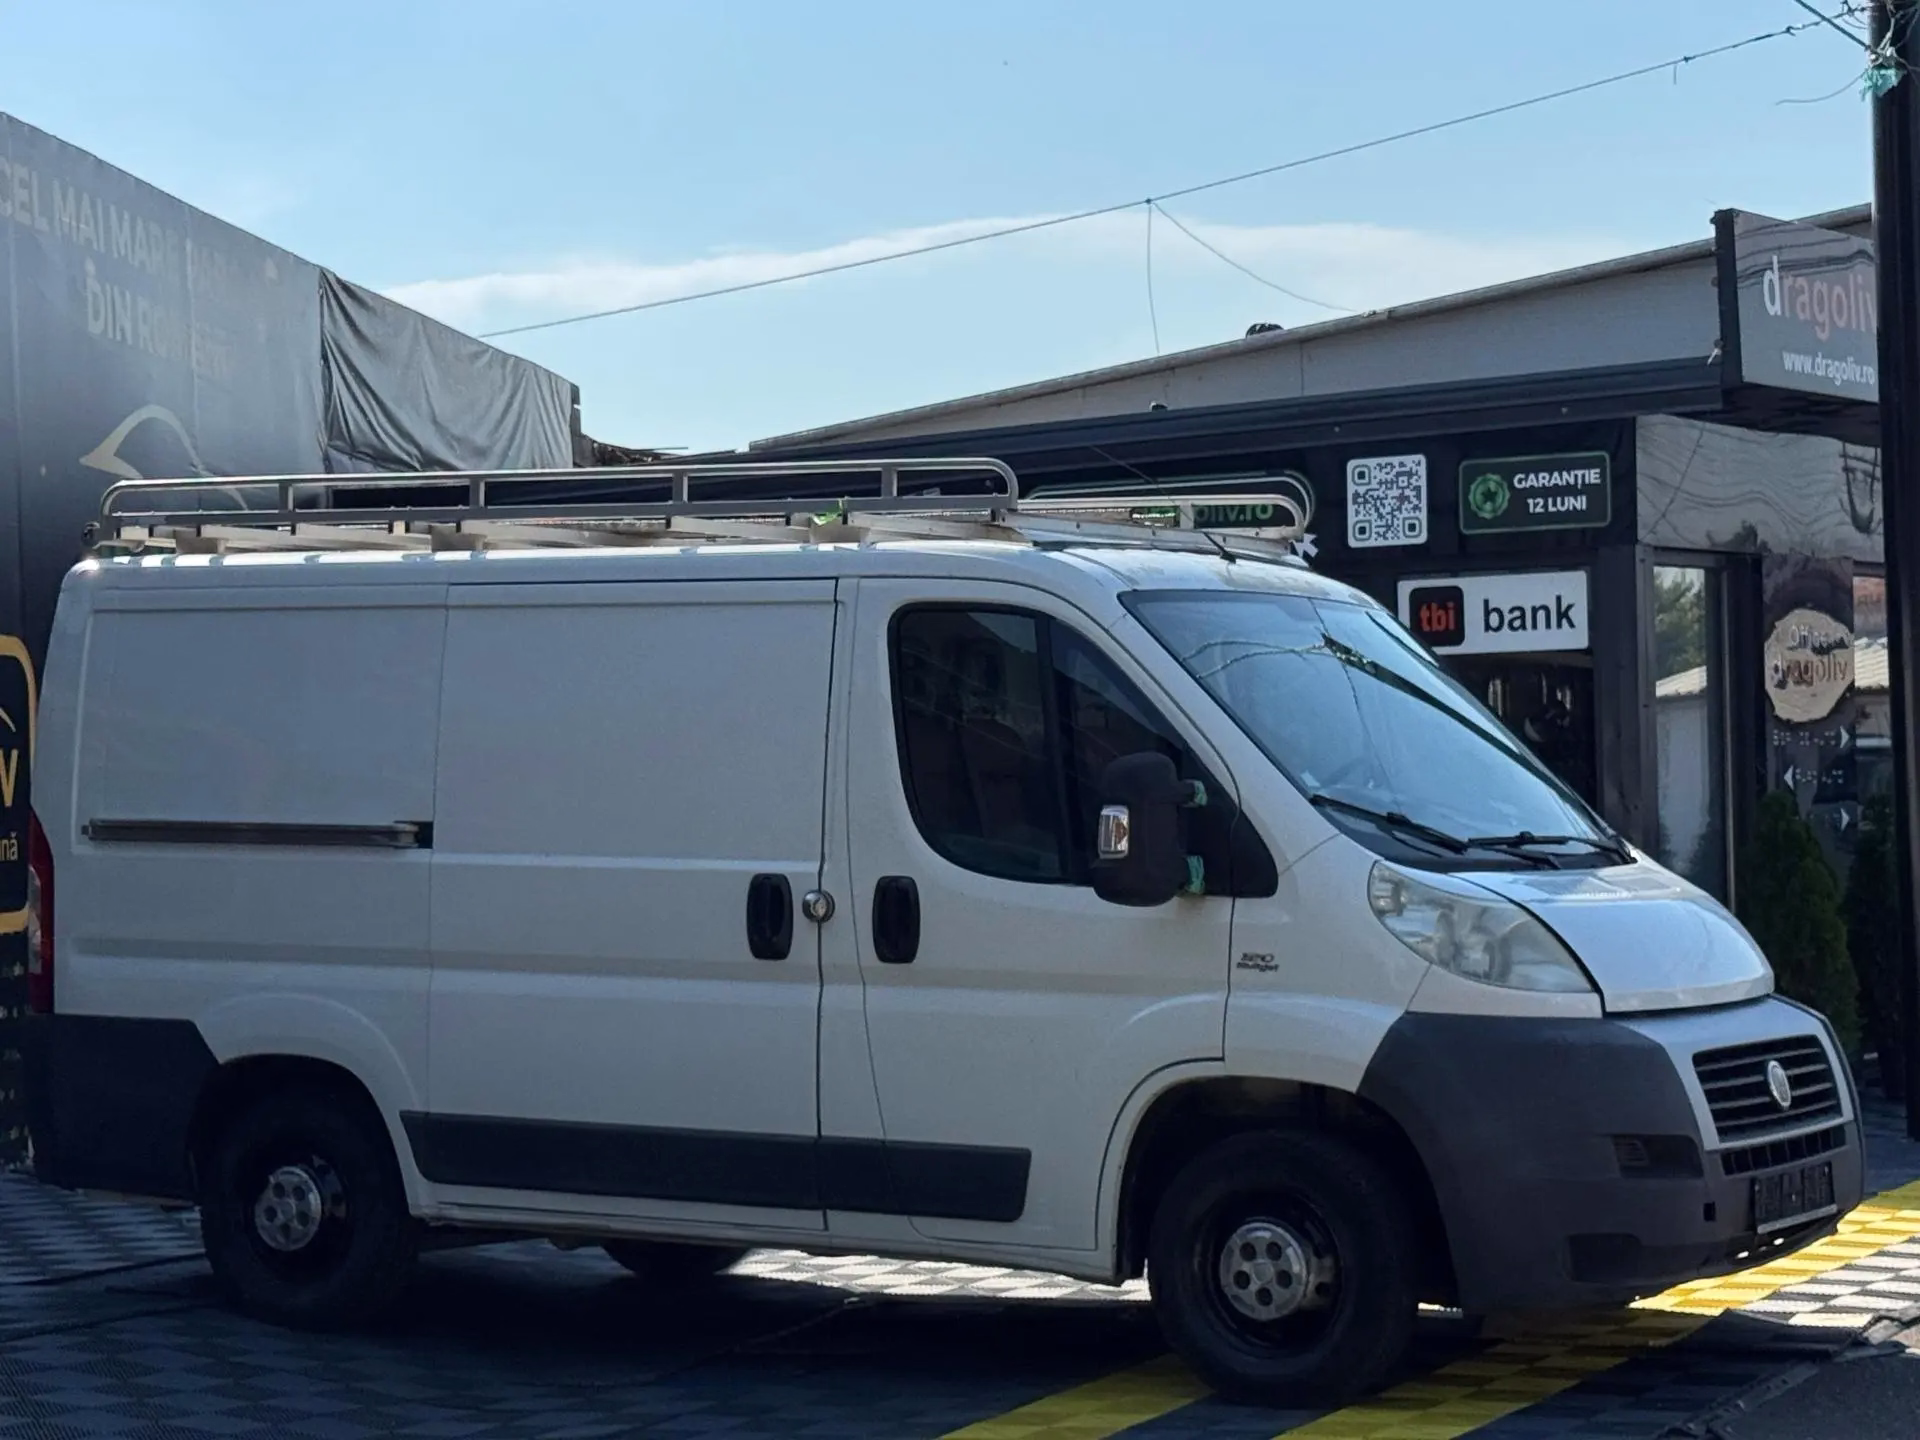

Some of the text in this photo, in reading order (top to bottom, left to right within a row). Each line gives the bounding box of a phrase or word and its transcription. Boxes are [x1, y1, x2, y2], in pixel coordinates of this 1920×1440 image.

[52, 177, 106, 254] MAI
[1782, 350, 1876, 386] www.dragoliv.ro
[1513, 468, 1601, 490] GARANȚIE
[1527, 495, 1587, 514] 12 LUNI
[1419, 595, 1576, 633] tbi bank
